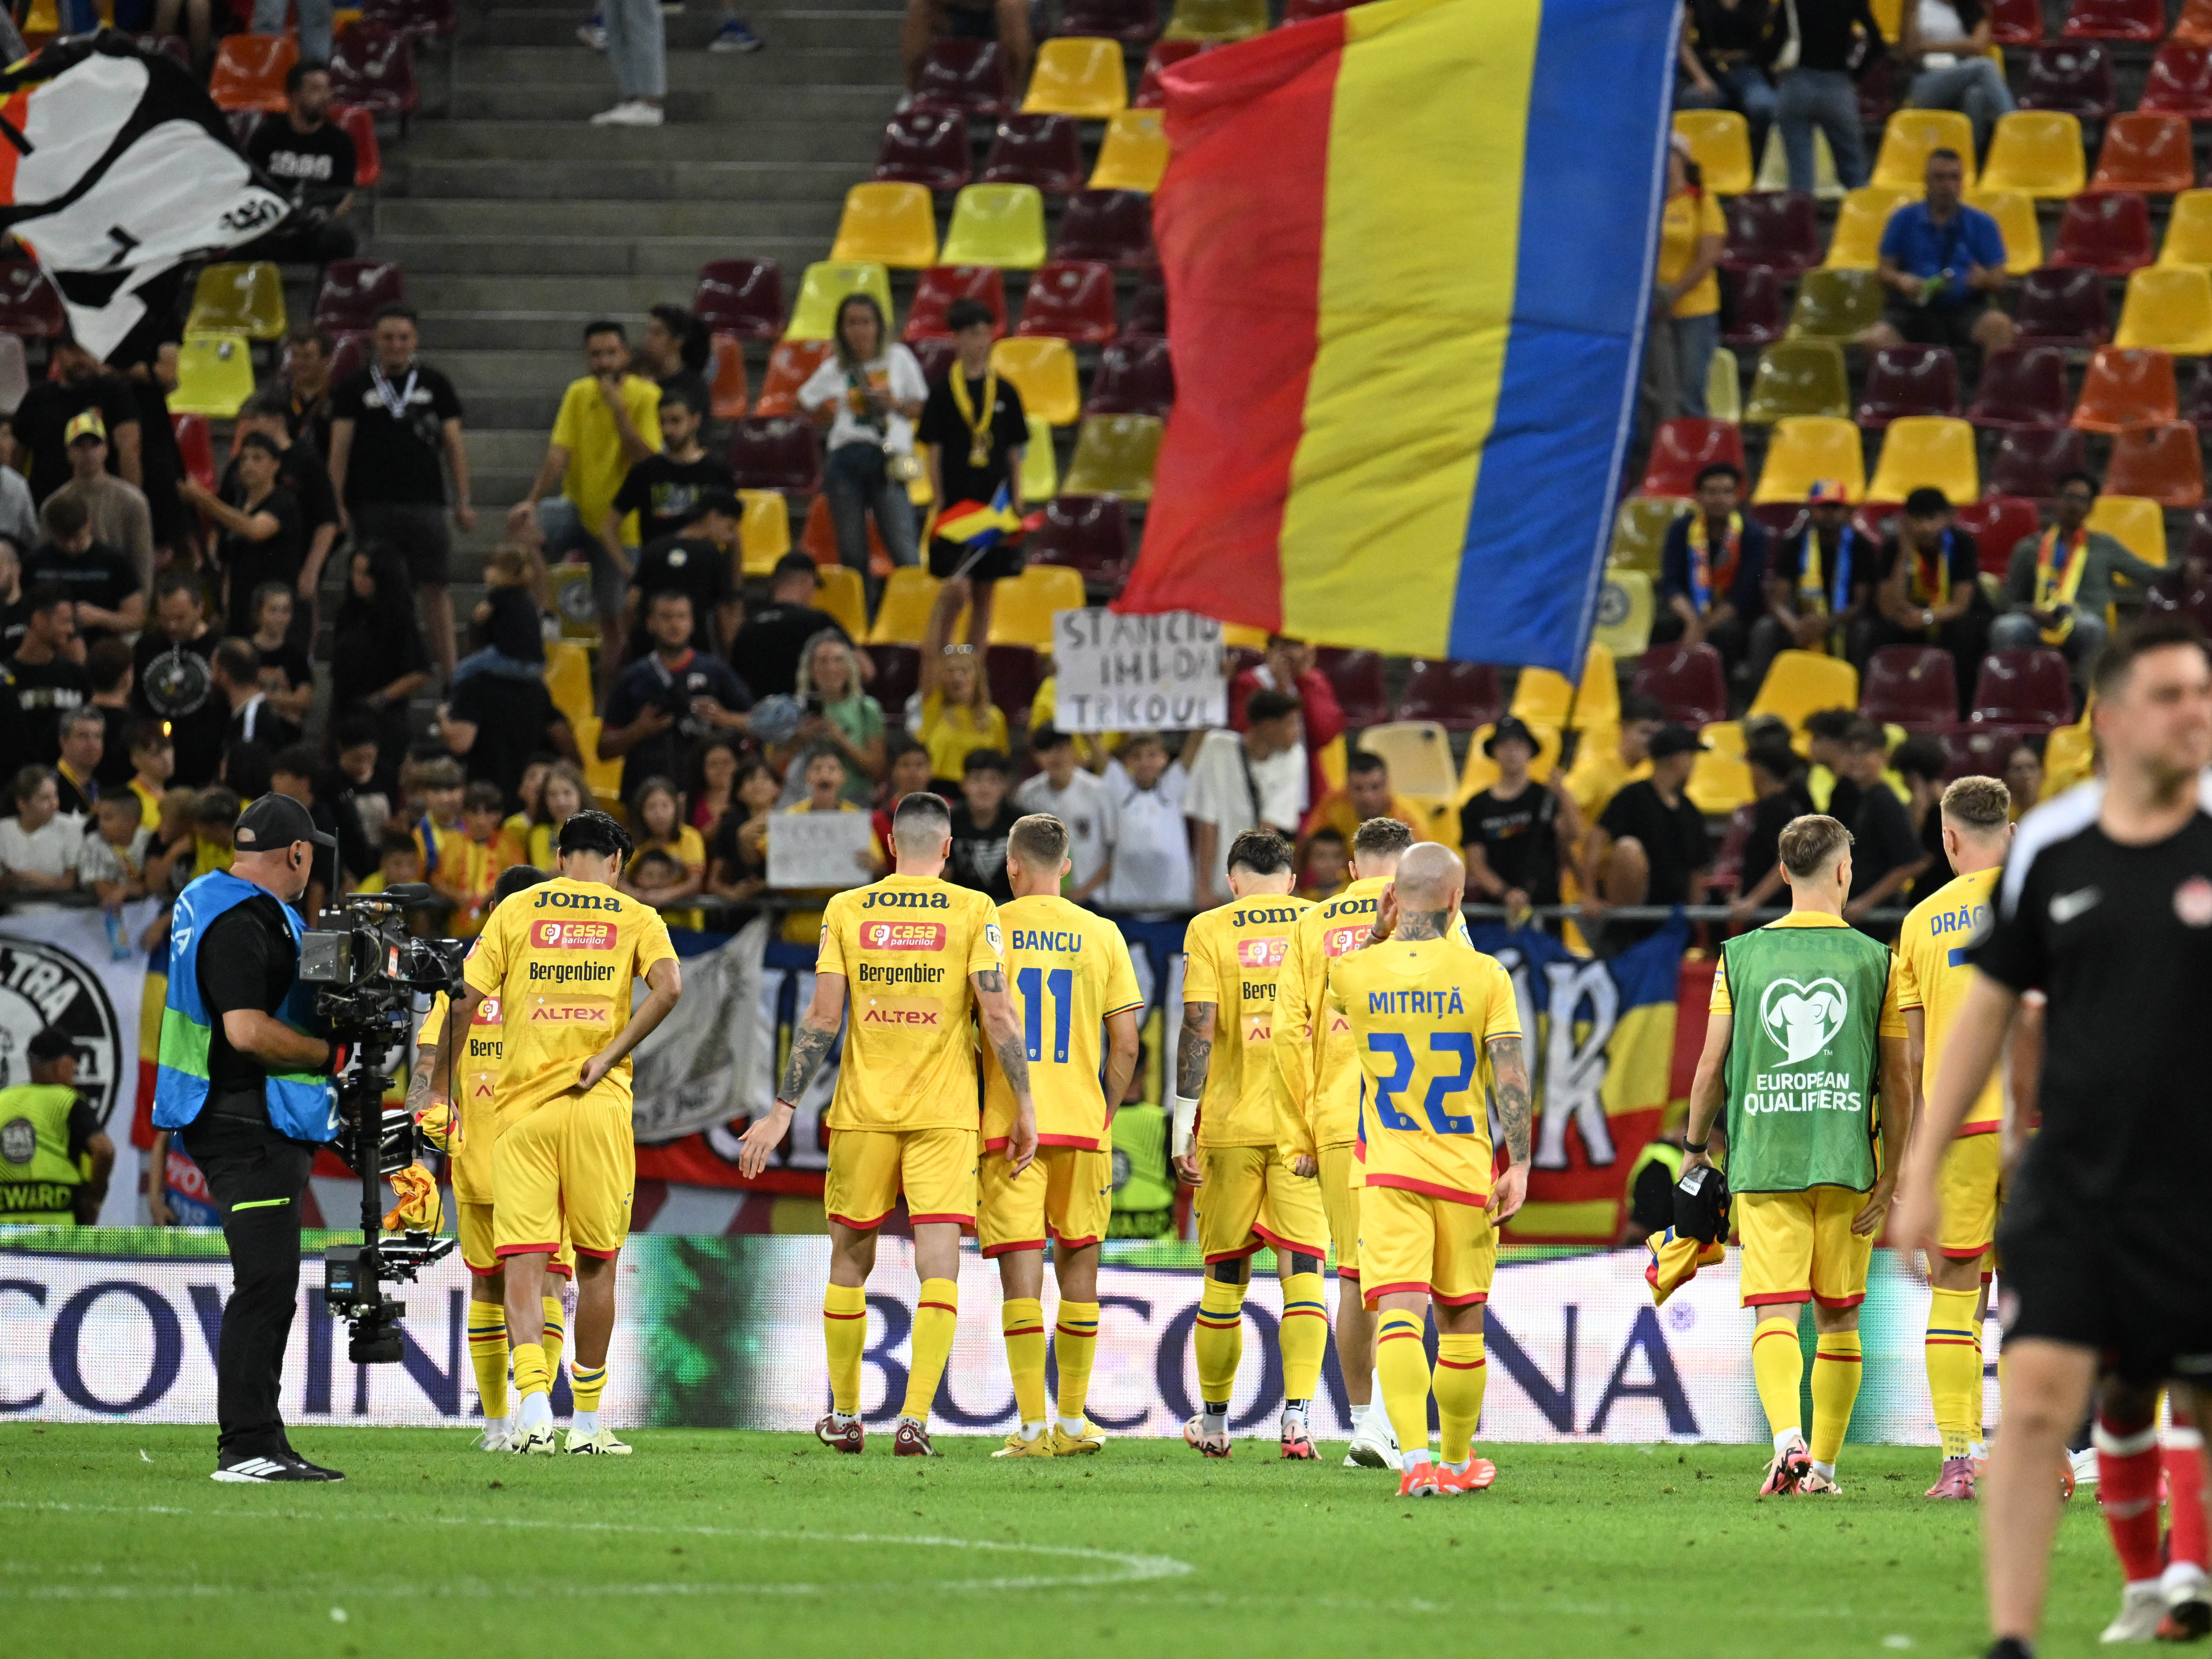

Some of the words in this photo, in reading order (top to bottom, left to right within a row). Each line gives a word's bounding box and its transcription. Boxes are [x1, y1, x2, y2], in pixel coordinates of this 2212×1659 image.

[534, 891, 622, 912] Joma
[862, 892, 950, 909] Joma
[563, 925, 608, 937] casa
[891, 938, 934, 946] pariurilor
[892, 926, 937, 938] casa
[1013, 930, 1081, 952] BANCU
[530, 960, 615, 983] Bergenbier
[859, 962, 945, 985] Bergenbier
[1369, 987, 1464, 1019] MITRIȚĂ
[1017, 967, 1073, 1063] 11
[1368, 1032, 1476, 1134] 22
[1757, 1071, 1849, 1090] EUROPEAN
[1744, 1090, 1861, 1116] QUALIFIERS
[0, 1184, 71, 1210] WARD
